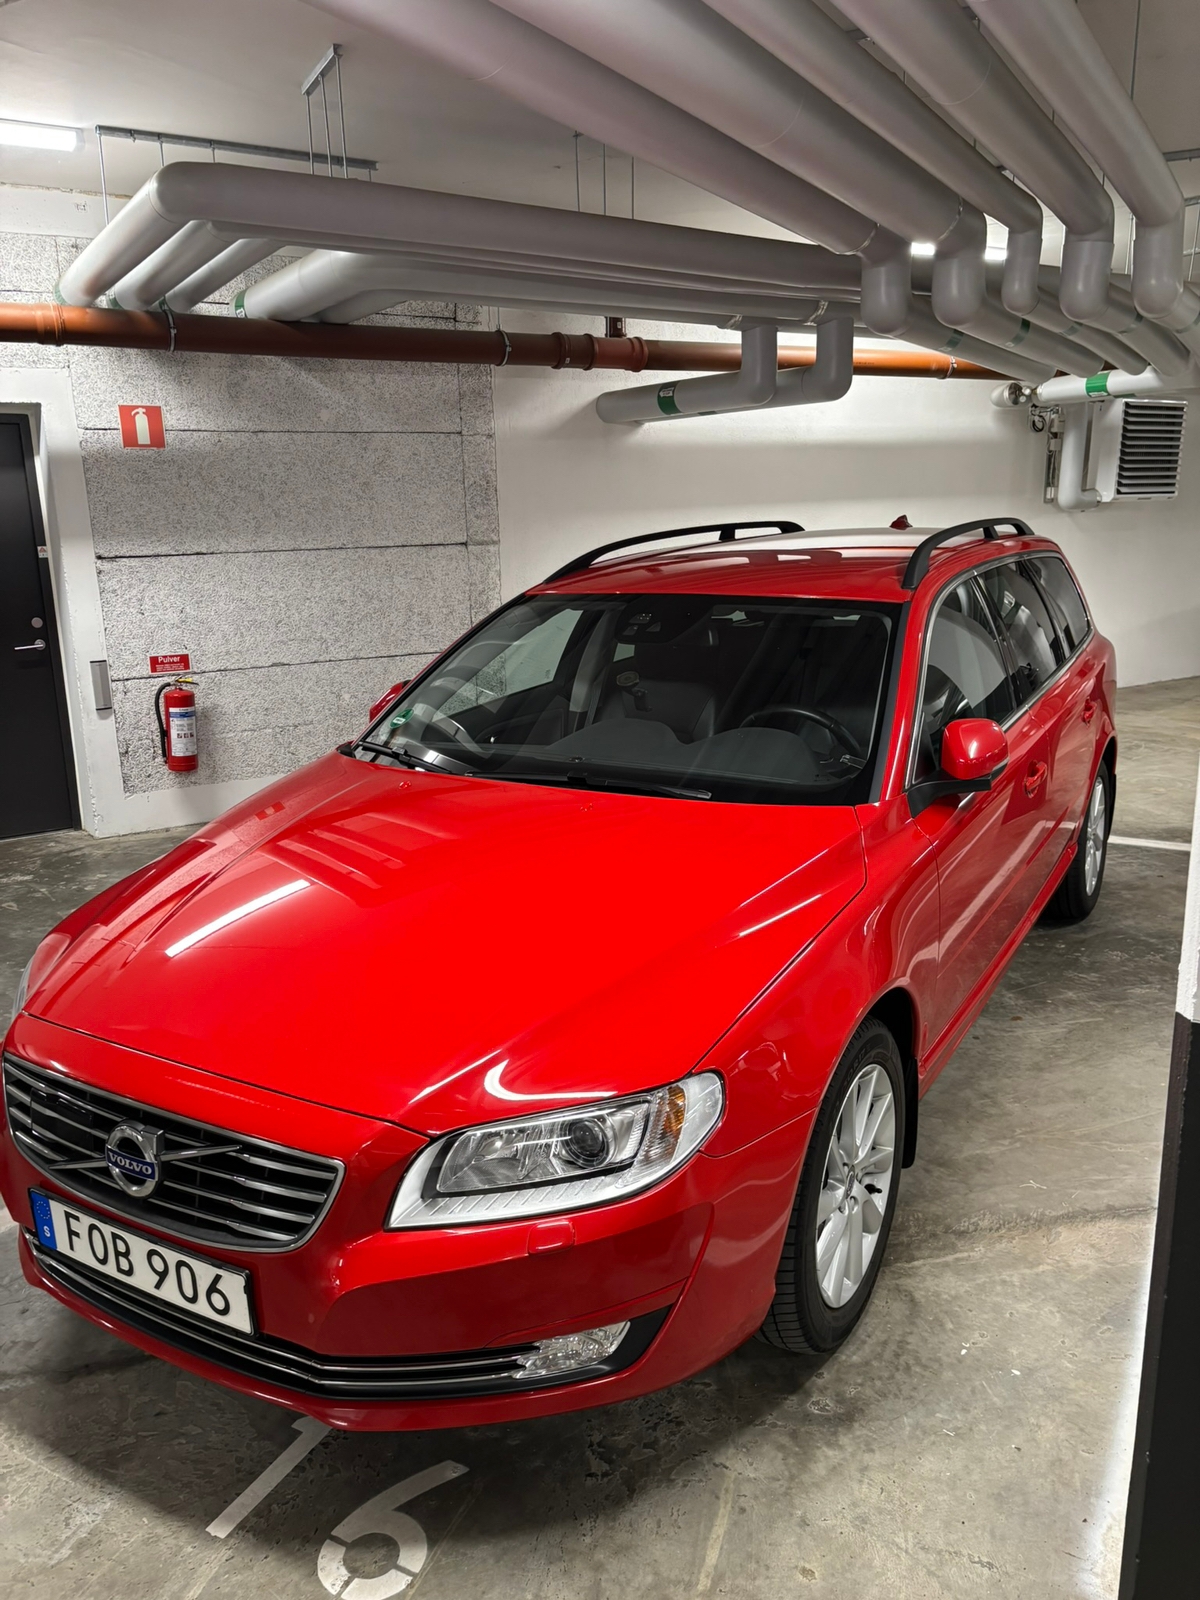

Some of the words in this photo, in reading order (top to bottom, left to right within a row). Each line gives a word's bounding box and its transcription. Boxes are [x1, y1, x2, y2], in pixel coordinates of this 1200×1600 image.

[107, 1150, 153, 1175] VOLVO
[43, 1225, 51, 1238] S
[64, 1209, 134, 1277] FOB
[146, 1248, 231, 1316] 906
